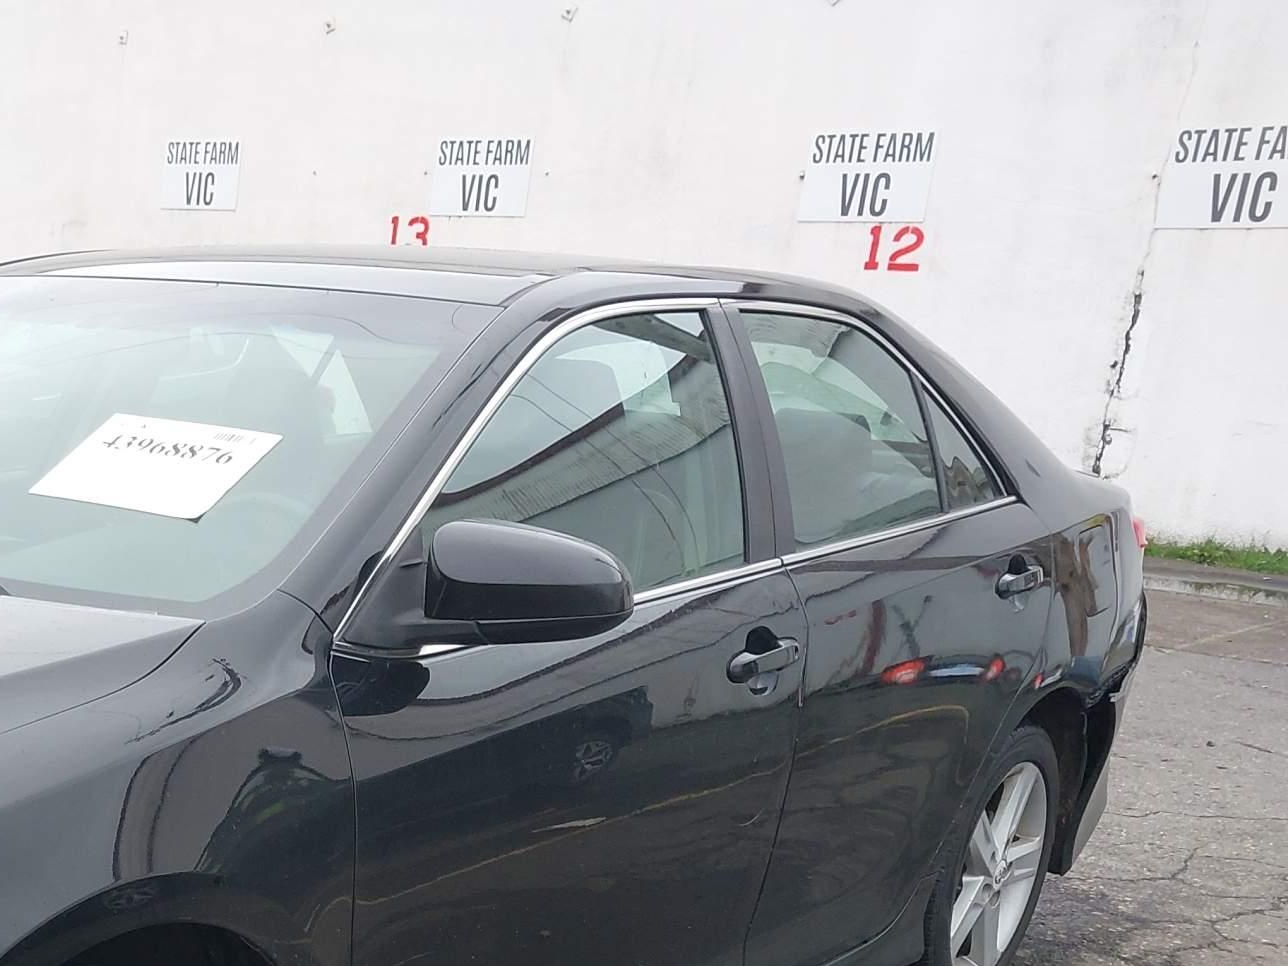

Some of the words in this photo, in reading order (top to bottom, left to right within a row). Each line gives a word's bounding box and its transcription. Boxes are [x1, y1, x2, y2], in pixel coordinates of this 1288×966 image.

[167, 141, 202, 165] STATE
[203, 141, 240, 165] FARM
[438, 140, 482, 166] STATE
[484, 139, 531, 166] FARM
[812, 133, 870, 164] STATE
[872, 131, 935, 163] FARM
[1174, 127, 1253, 164] STATE
[1254, 125, 1288, 161] FA
[185, 171, 215, 206] VIC
[462, 174, 499, 212] VIC
[840, 172, 891, 217] VIC
[1210, 171, 1278, 223] VIC
[390, 215, 430, 247] 13
[862, 223, 927, 273] 12
[103, 434, 233, 465] 43968876
